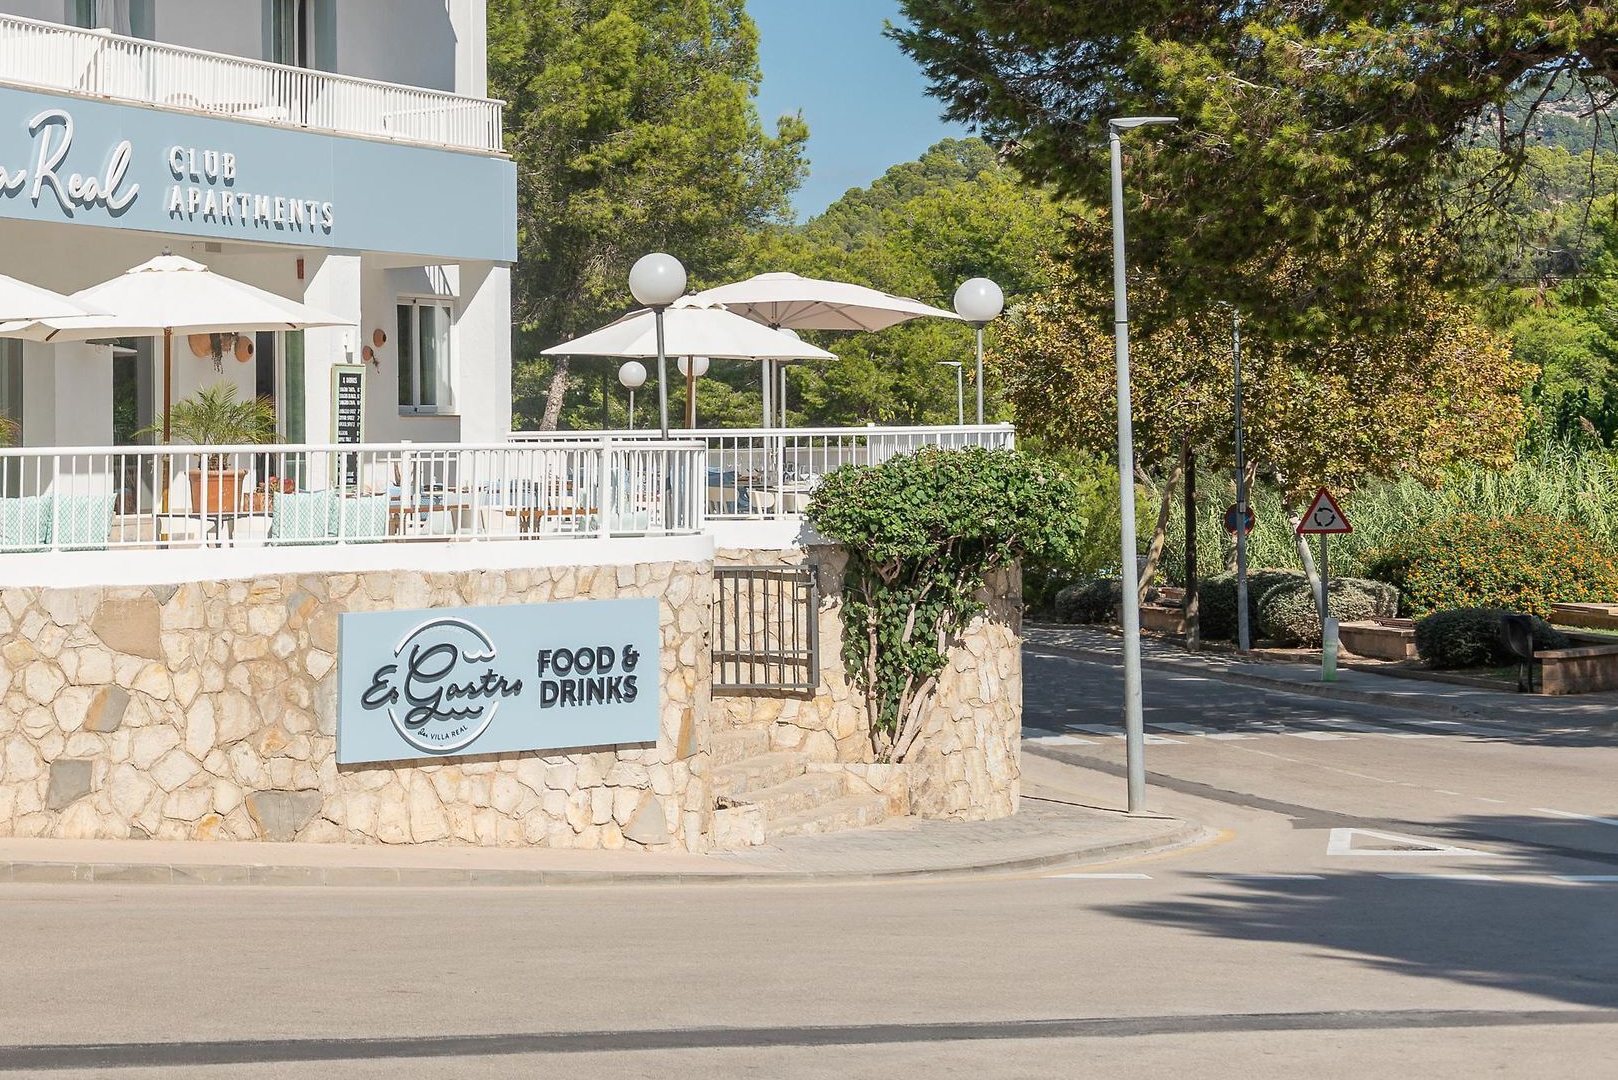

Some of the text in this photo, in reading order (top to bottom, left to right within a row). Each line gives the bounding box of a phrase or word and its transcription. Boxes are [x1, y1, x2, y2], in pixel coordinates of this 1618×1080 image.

[29, 108, 140, 209] Real
[169, 145, 236, 180] CLUB
[169, 184, 334, 229] APARTMENTS
[538, 644, 640, 675] FOOD &
[404, 643, 523, 727] Gastro
[540, 675, 638, 707] DRINKS
[430, 732, 450, 740] VILLA
[451, 725, 468, 737] REAL
